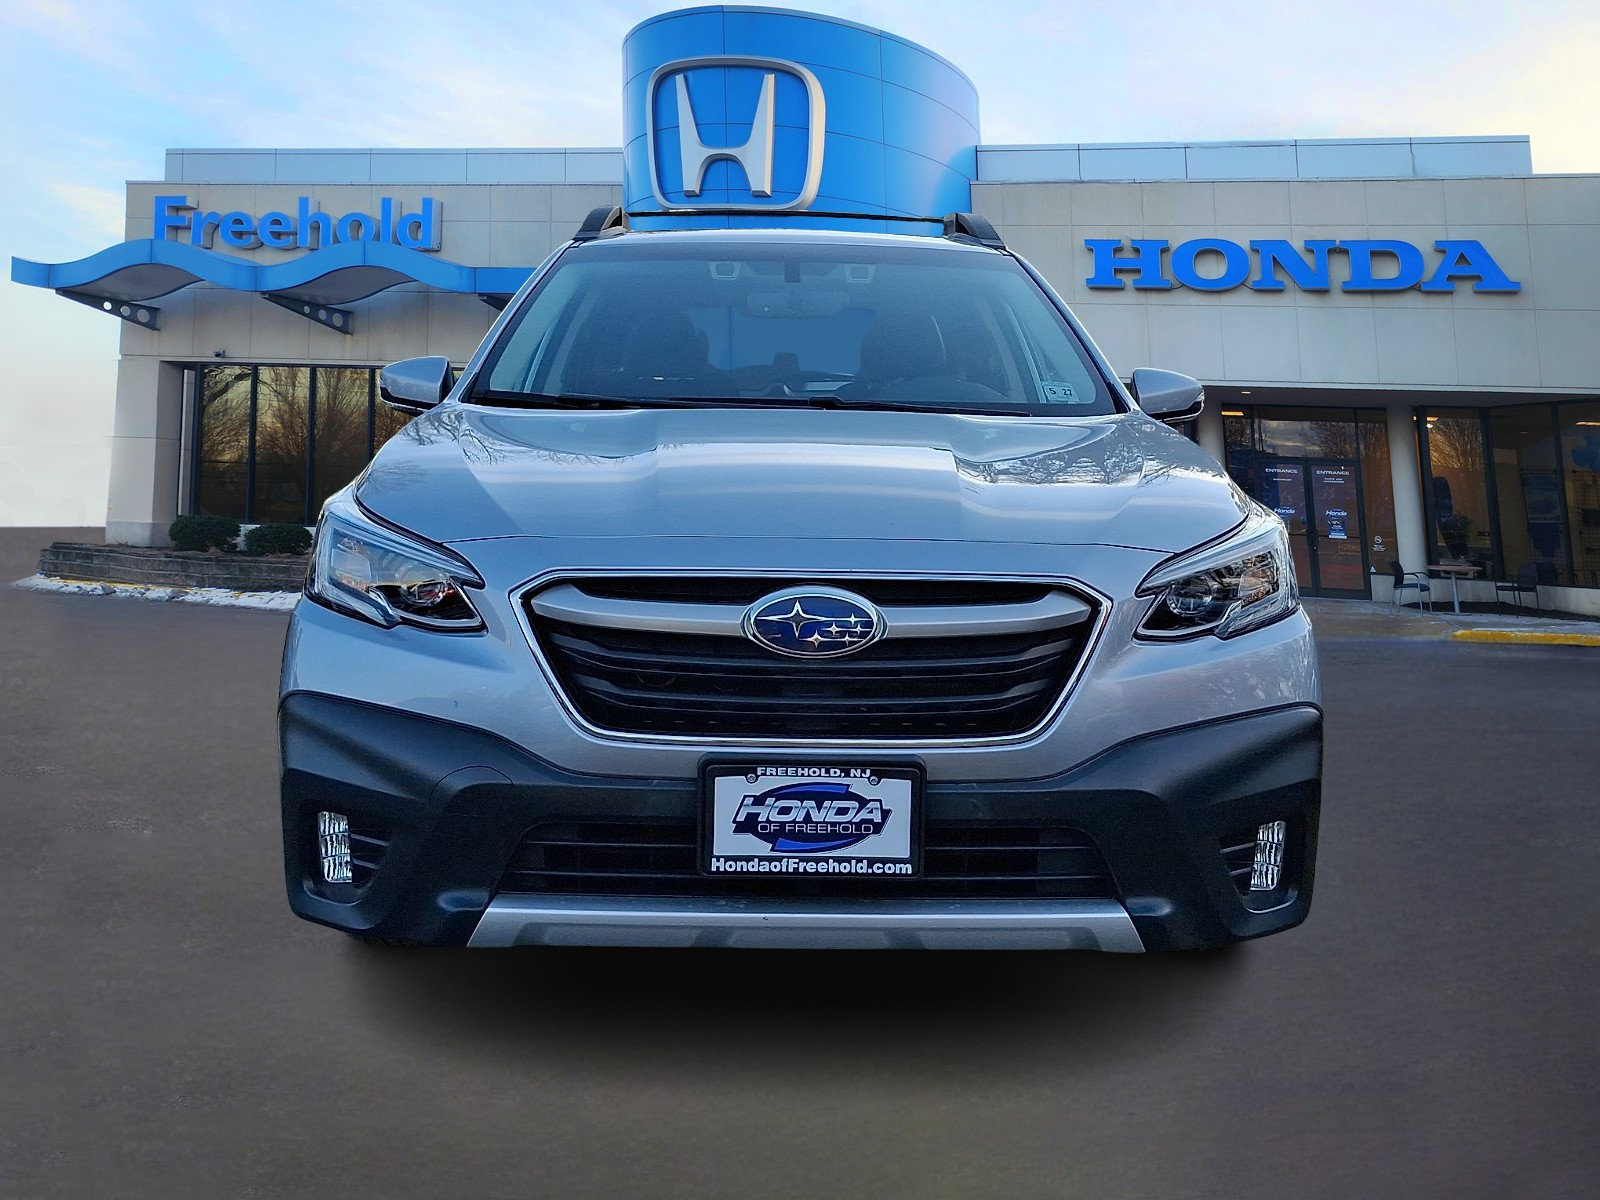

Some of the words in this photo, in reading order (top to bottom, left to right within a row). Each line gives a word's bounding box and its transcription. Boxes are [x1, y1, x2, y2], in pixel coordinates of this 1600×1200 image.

[154, 195, 442, 251] Freehold
[1084, 238, 1521, 293] HONDA
[757, 767, 845, 778] FREEHOLD,
[850, 769, 871, 778] NJ
[736, 797, 882, 823] HONDA
[758, 823, 781, 833] OF
[785, 823, 873, 834] FREEHOLD
[711, 858, 912, 874] HondaofFreehold.com
